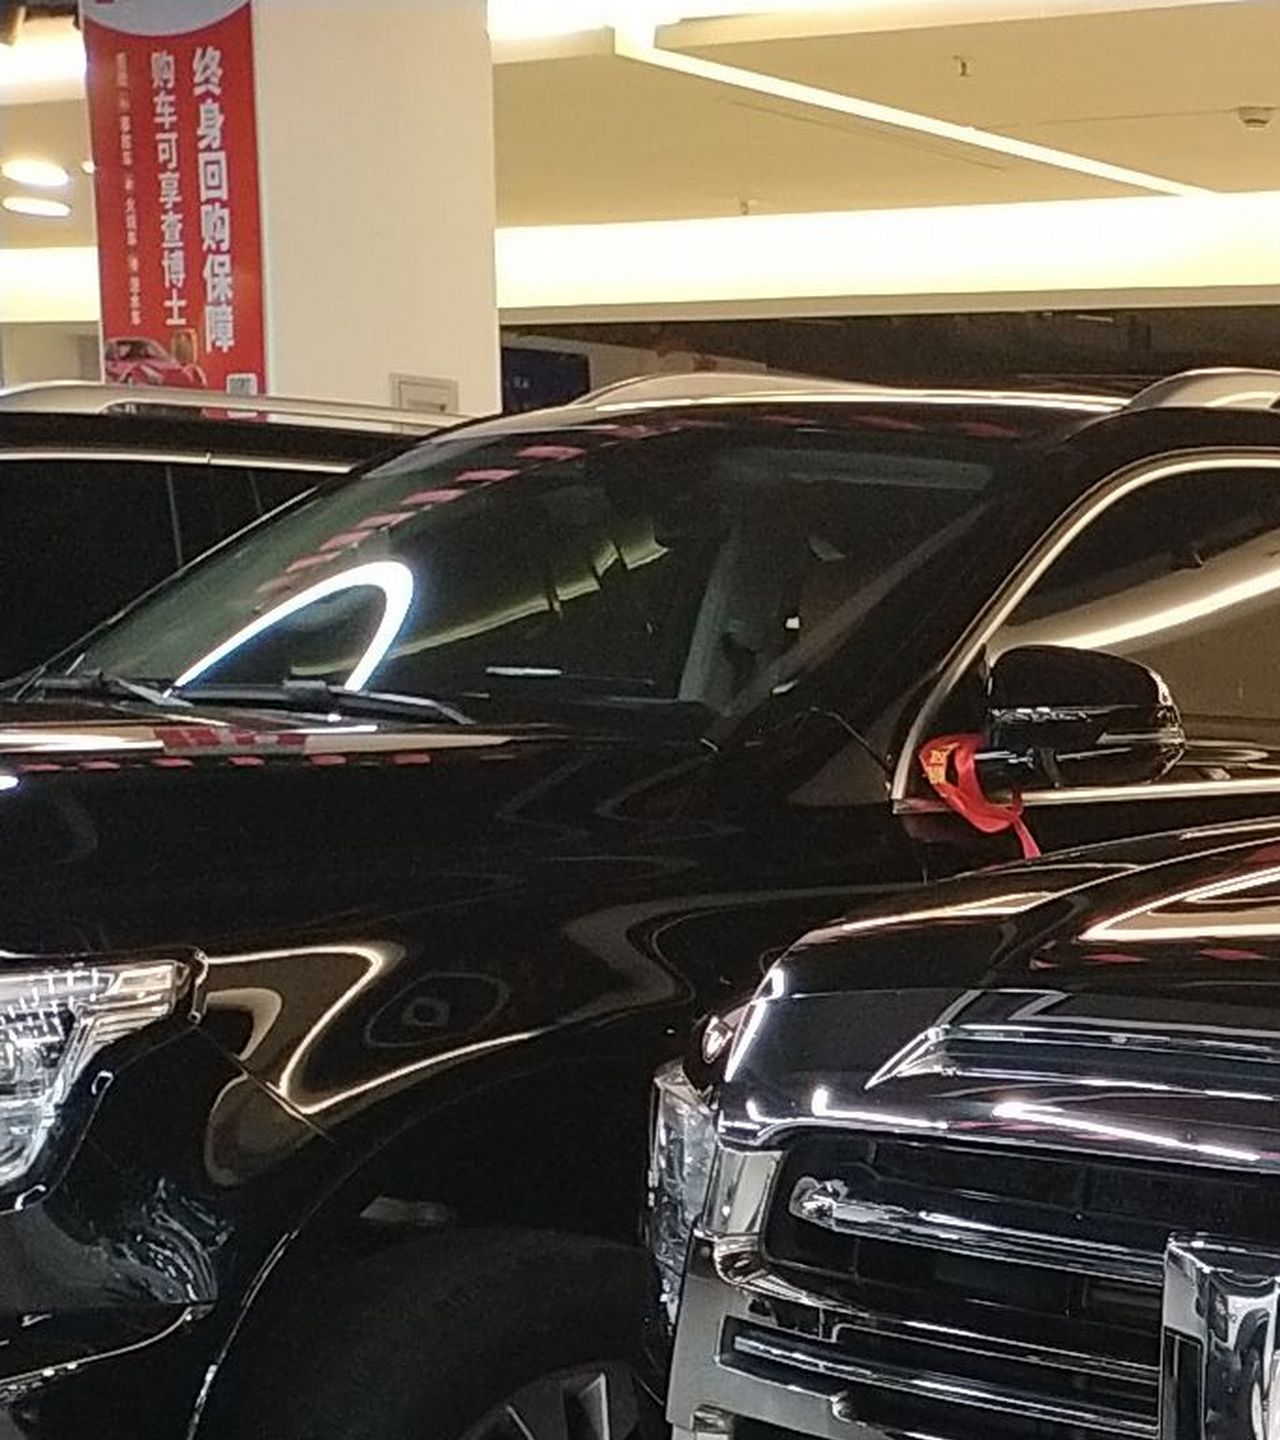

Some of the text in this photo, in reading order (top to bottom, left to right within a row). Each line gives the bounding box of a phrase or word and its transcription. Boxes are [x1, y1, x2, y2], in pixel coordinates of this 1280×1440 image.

[150, 50, 188, 327] 购车可享查博士
[192, 45, 235, 353] 终身回购保障
